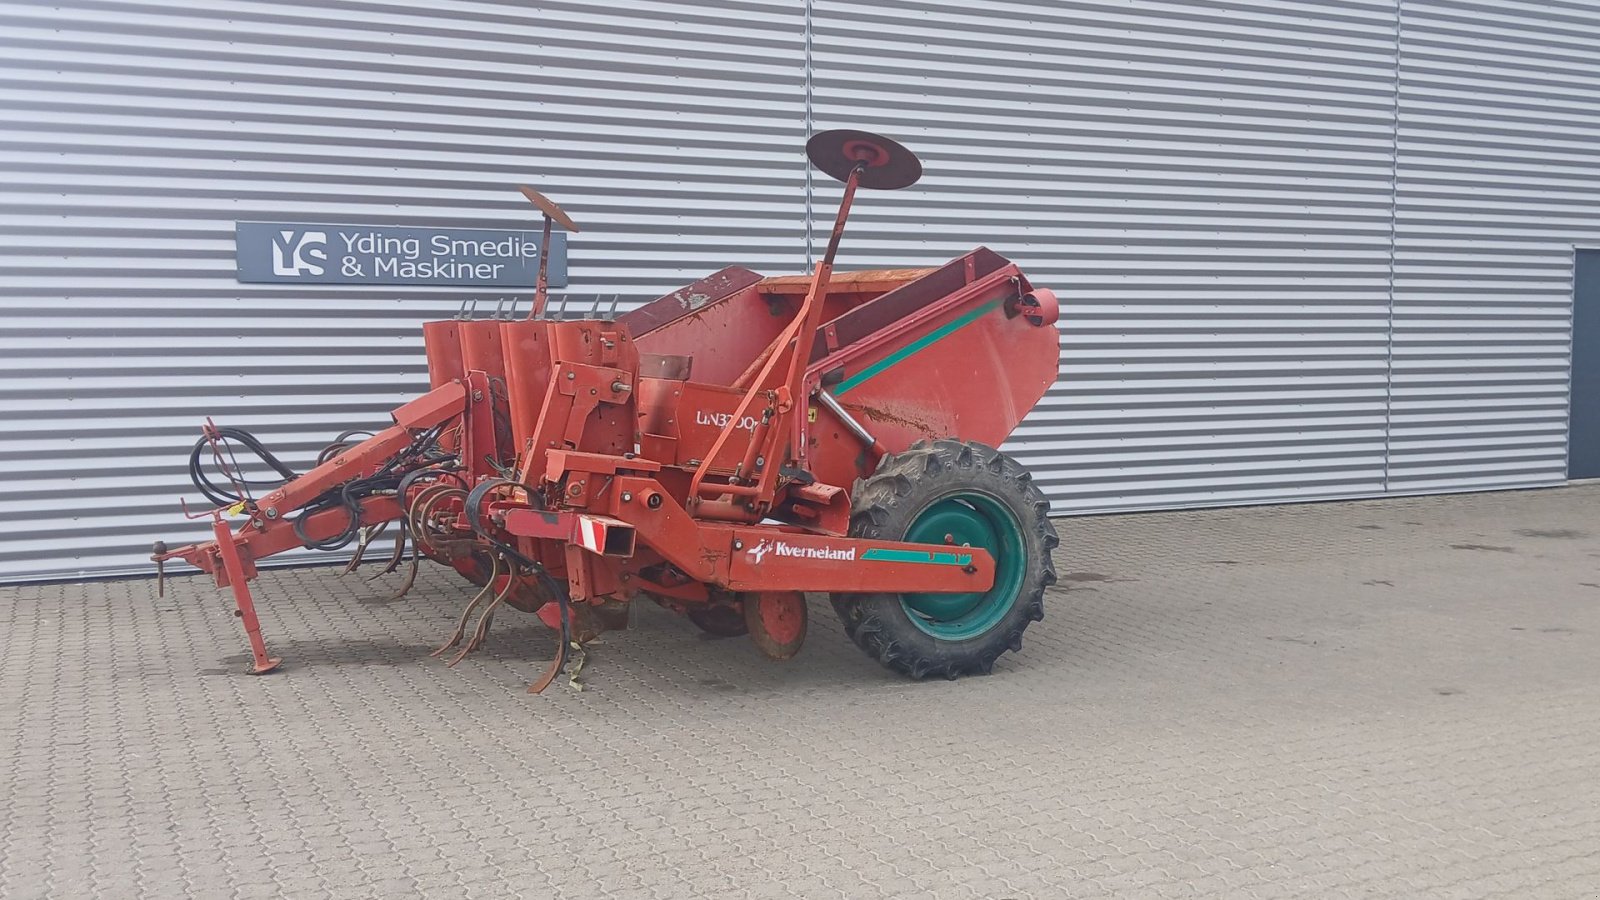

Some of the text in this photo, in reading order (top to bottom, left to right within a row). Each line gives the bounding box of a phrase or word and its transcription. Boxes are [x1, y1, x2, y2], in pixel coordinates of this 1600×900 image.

[339, 231, 537, 260] Yding Smedie
[341, 255, 505, 279] & Maskiner
[776, 541, 856, 561] Kverneland
